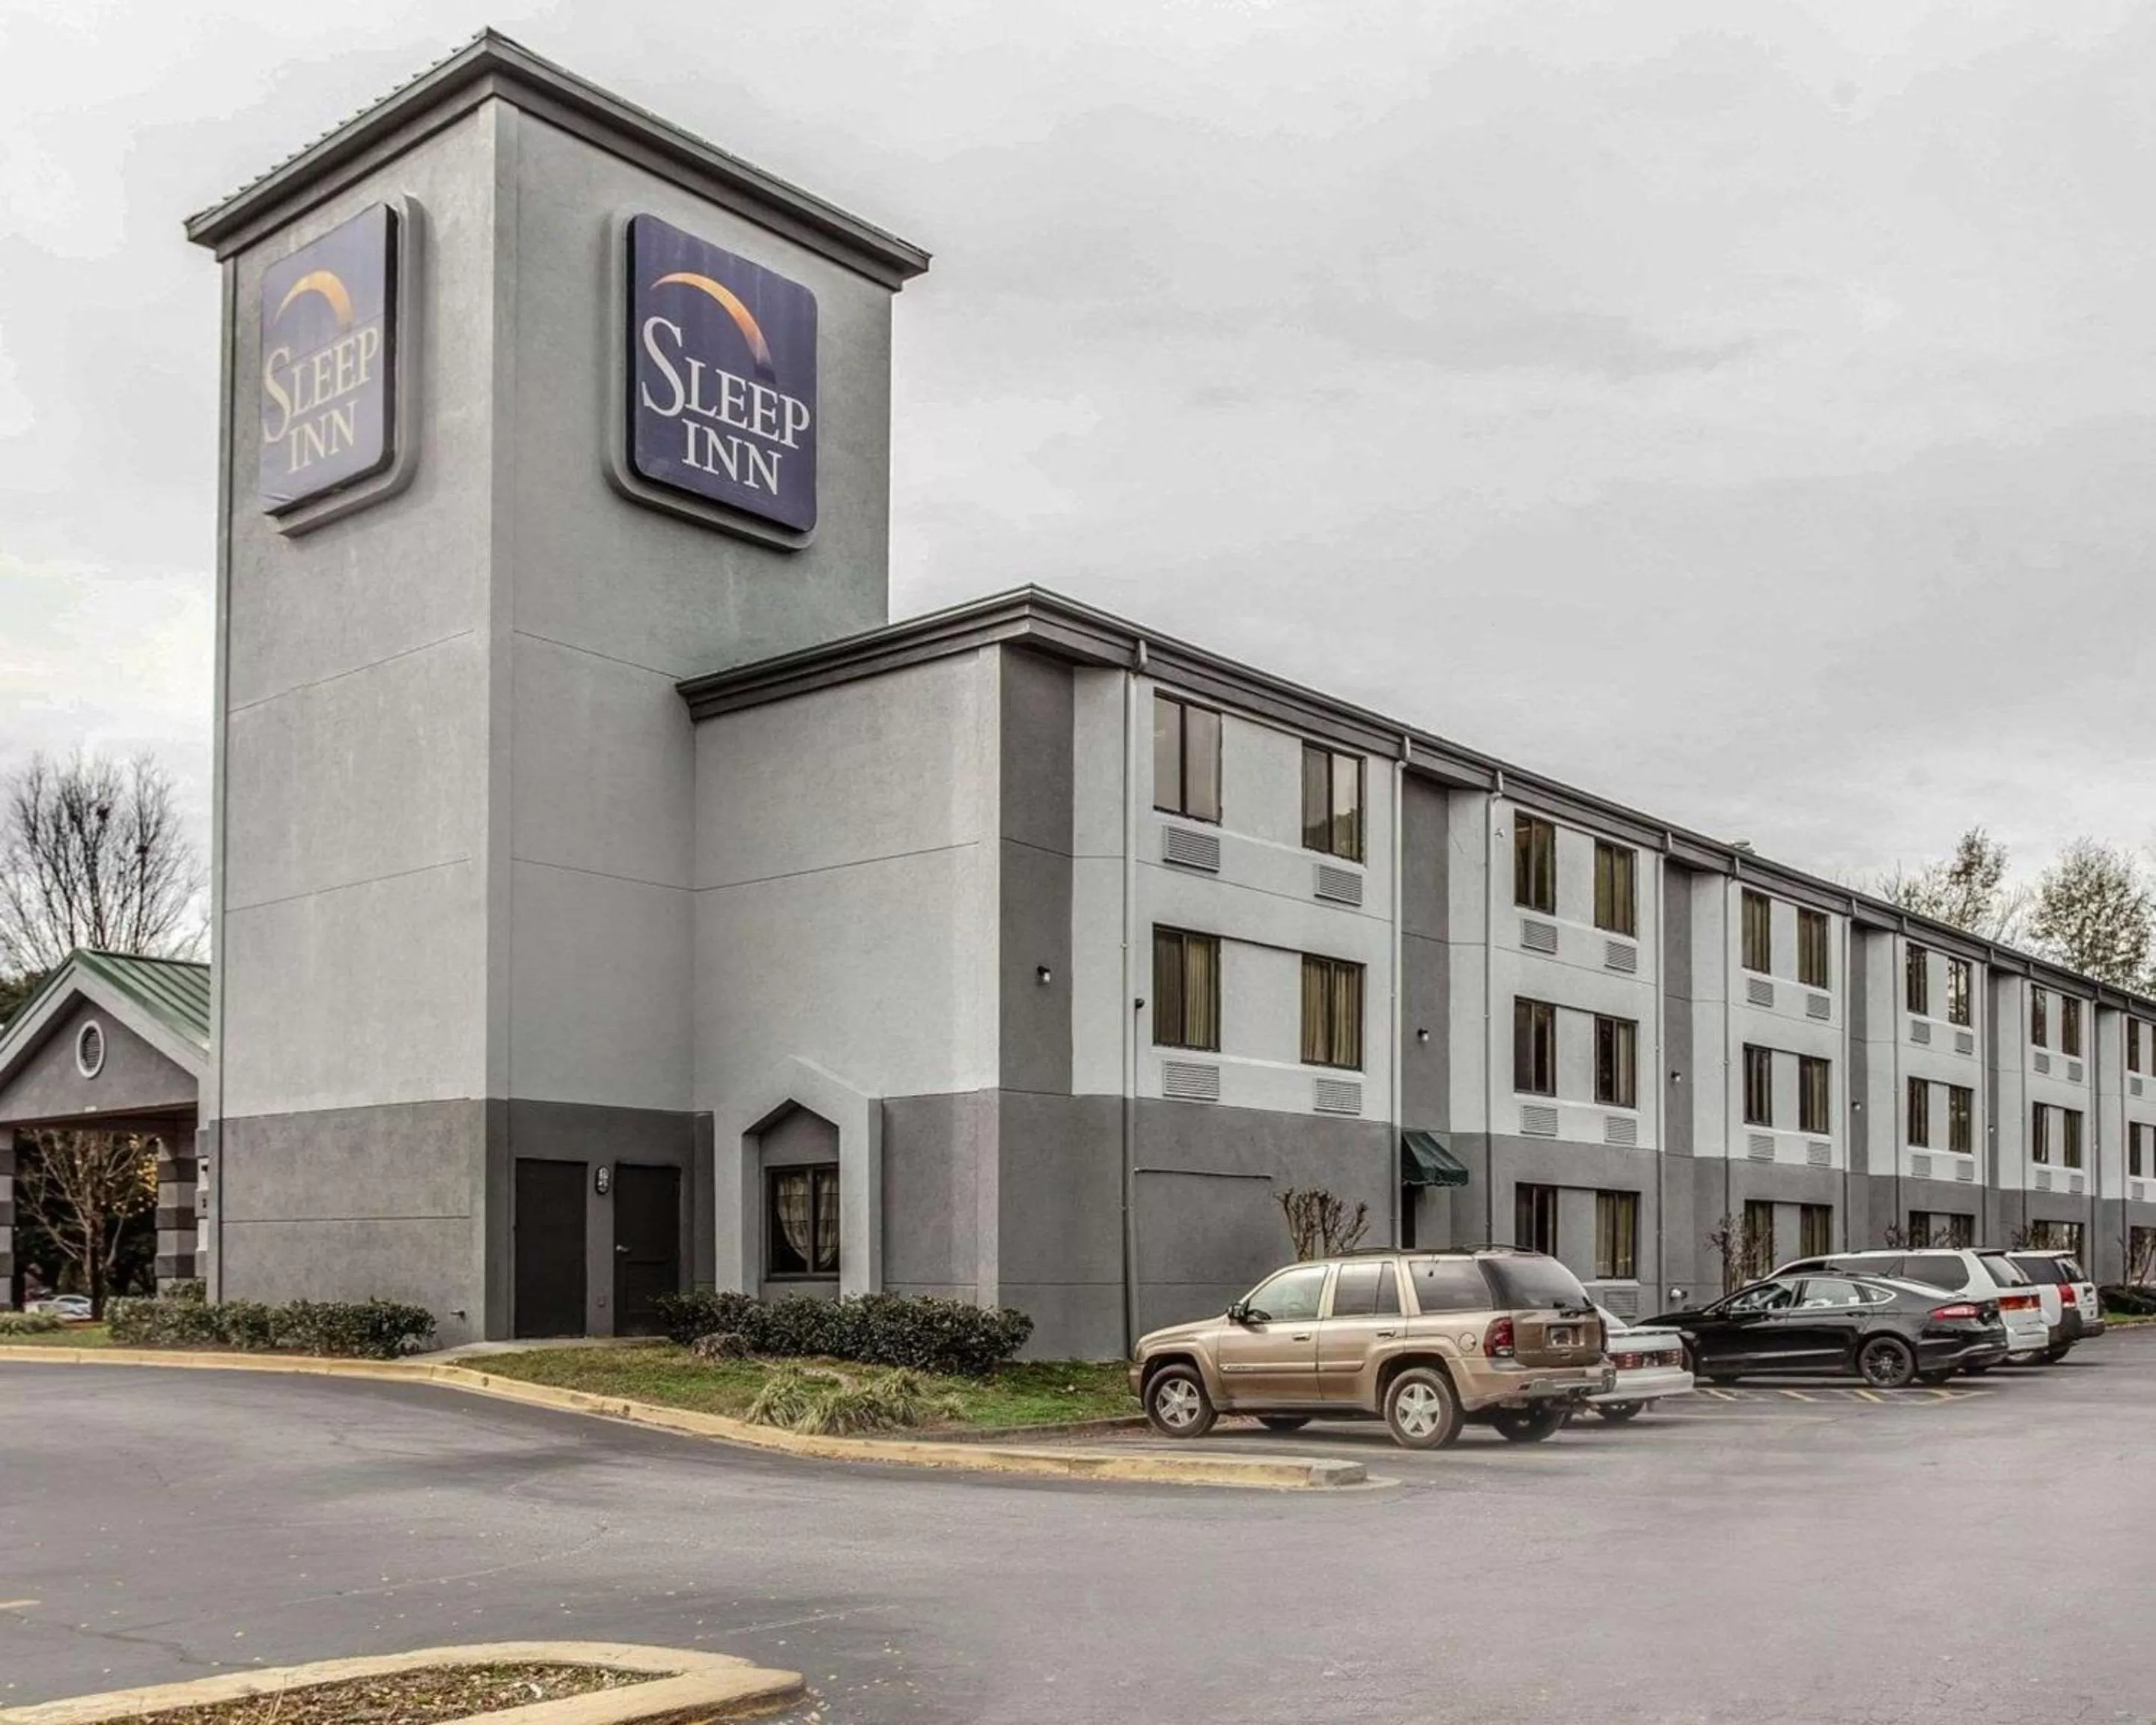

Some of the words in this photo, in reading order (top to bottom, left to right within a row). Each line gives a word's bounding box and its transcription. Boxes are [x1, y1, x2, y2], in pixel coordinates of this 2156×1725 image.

[264, 326, 380, 444] SLEEP
[642, 316, 811, 450] SLEEP
[287, 400, 359, 474] INN
[681, 418, 782, 496] INN
